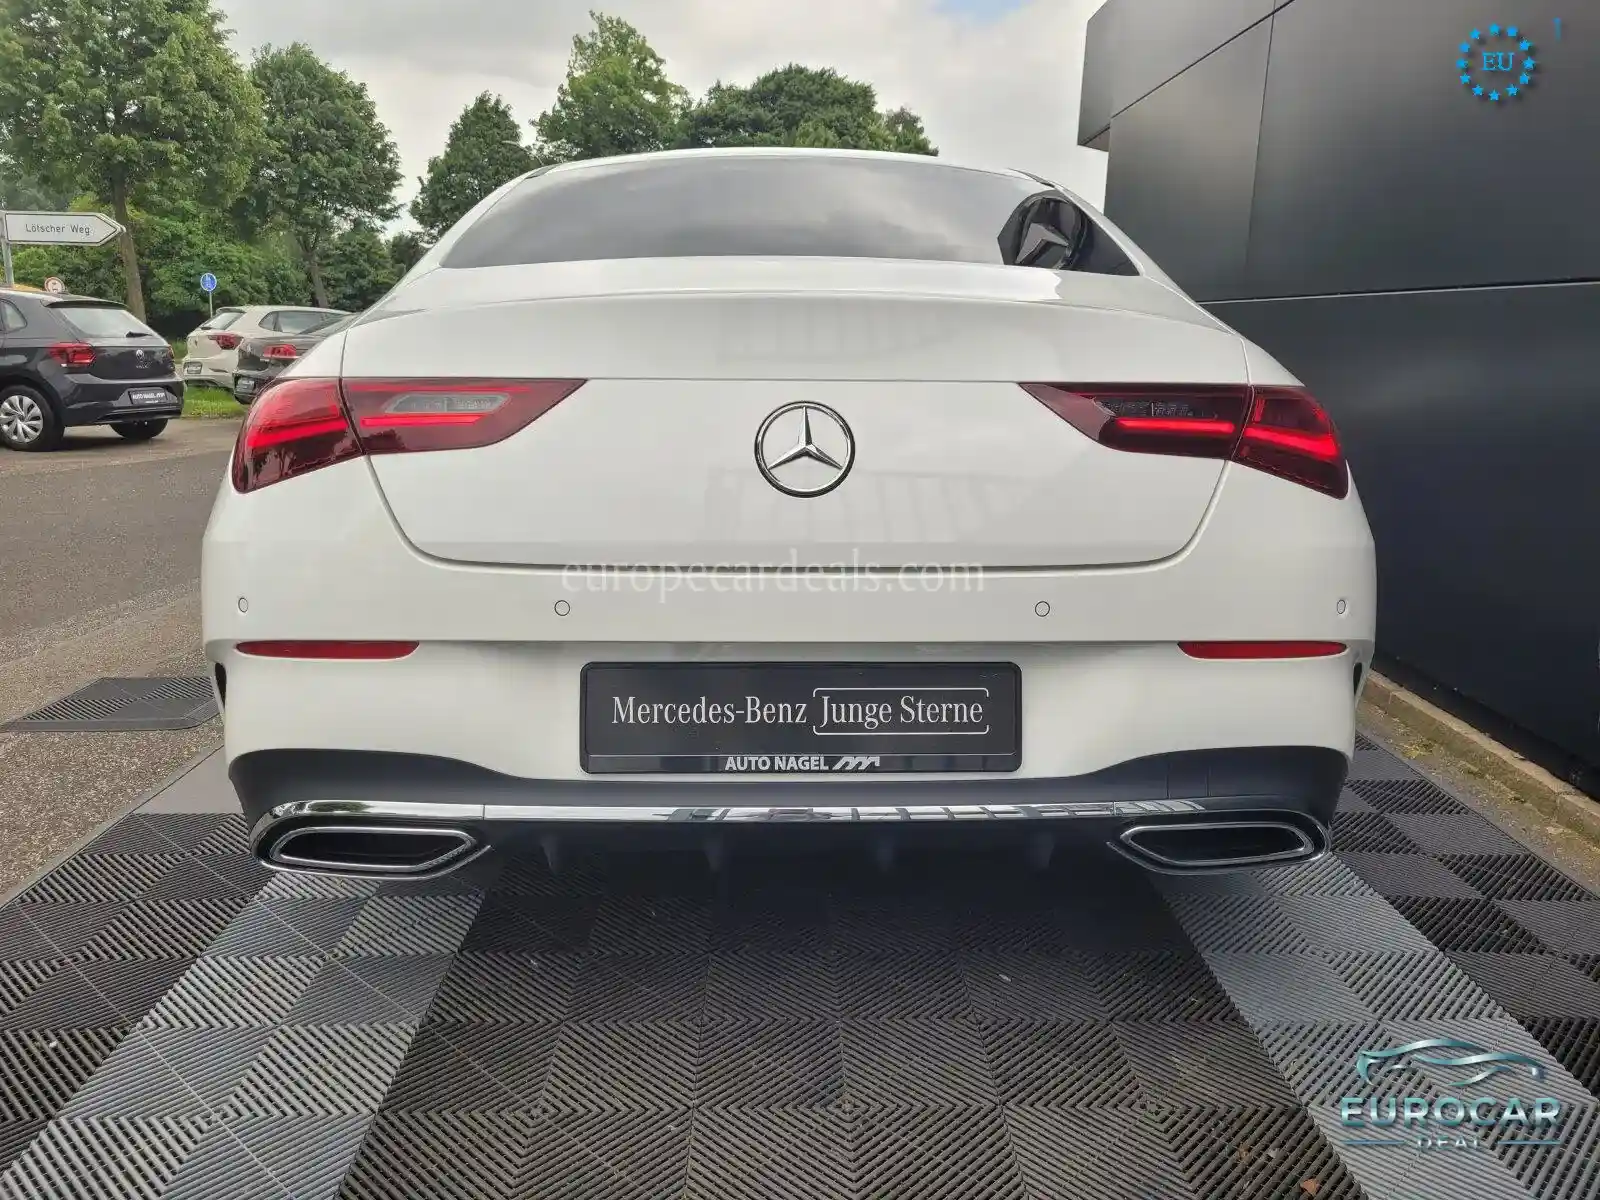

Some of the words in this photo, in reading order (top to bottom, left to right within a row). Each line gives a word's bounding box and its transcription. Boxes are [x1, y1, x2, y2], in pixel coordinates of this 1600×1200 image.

[25, 223, 65, 233] Lötscher
[70, 224, 91, 236] Weg
[611, 695, 807, 725] Mercedes-Benz
[819, 696, 892, 730] Junge
[899, 695, 983, 724] Sterne
[725, 756, 771, 771] AUTO
[774, 756, 829, 771] NAGEL
